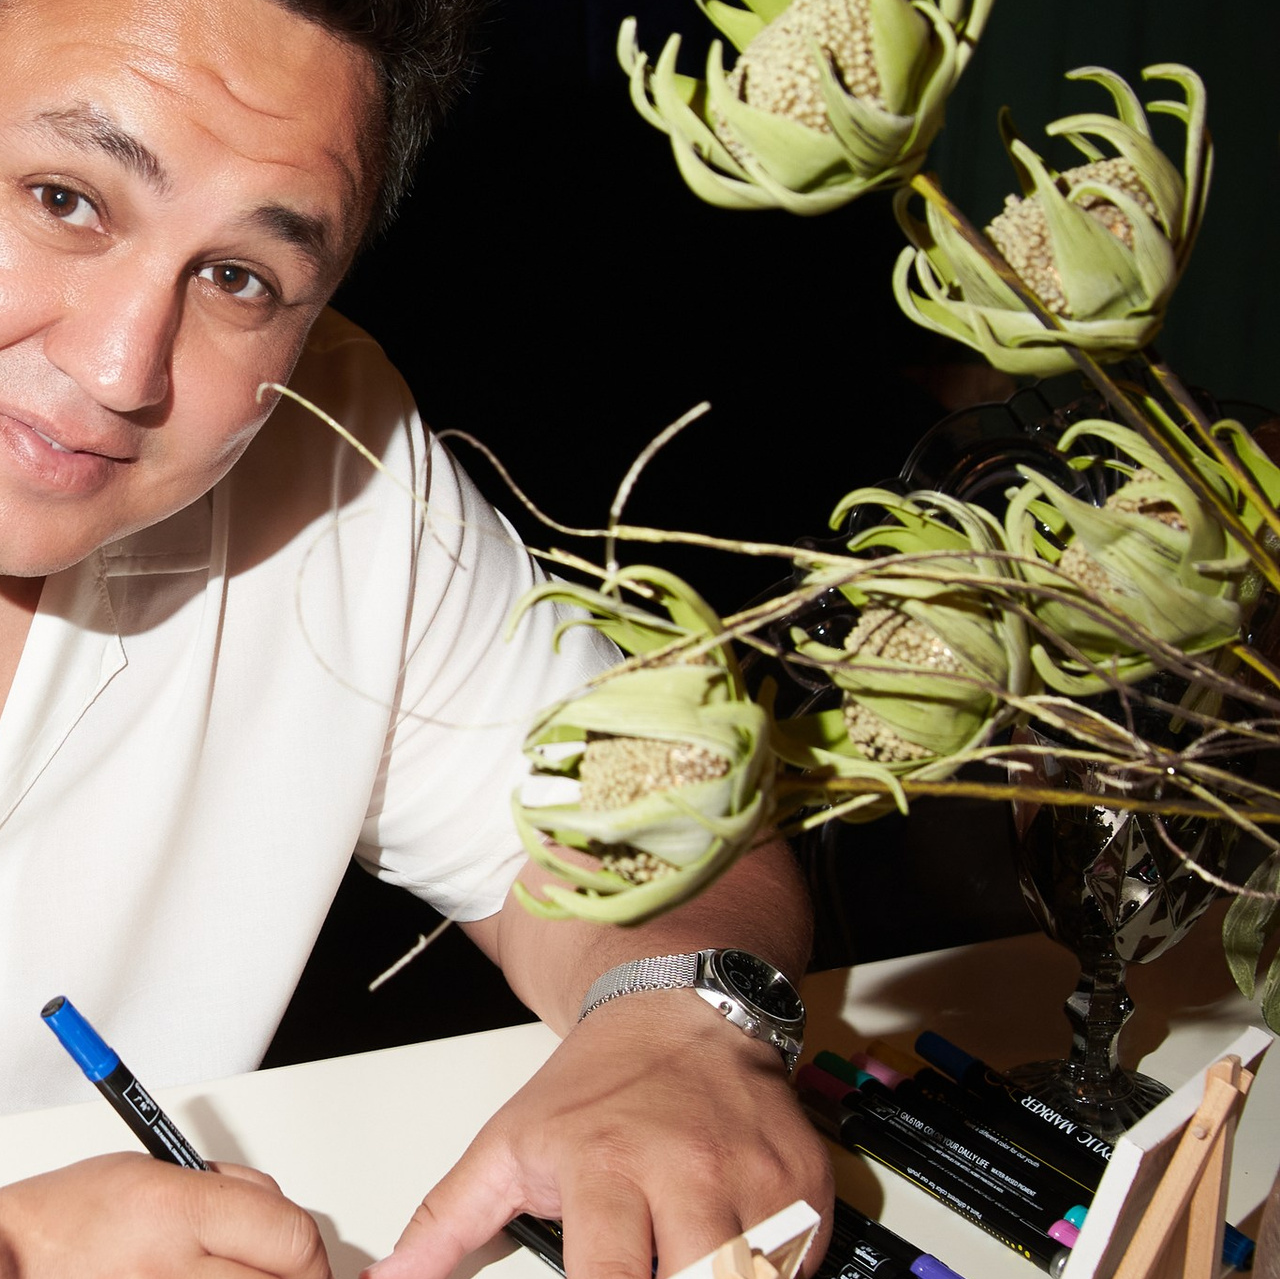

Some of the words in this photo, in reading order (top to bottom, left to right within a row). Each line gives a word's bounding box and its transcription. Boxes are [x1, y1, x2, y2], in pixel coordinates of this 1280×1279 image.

[1021, 1095, 1078, 1134] MARKER
[941, 1136, 960, 1151] YOUR
[974, 1155, 990, 1169] LIFE
